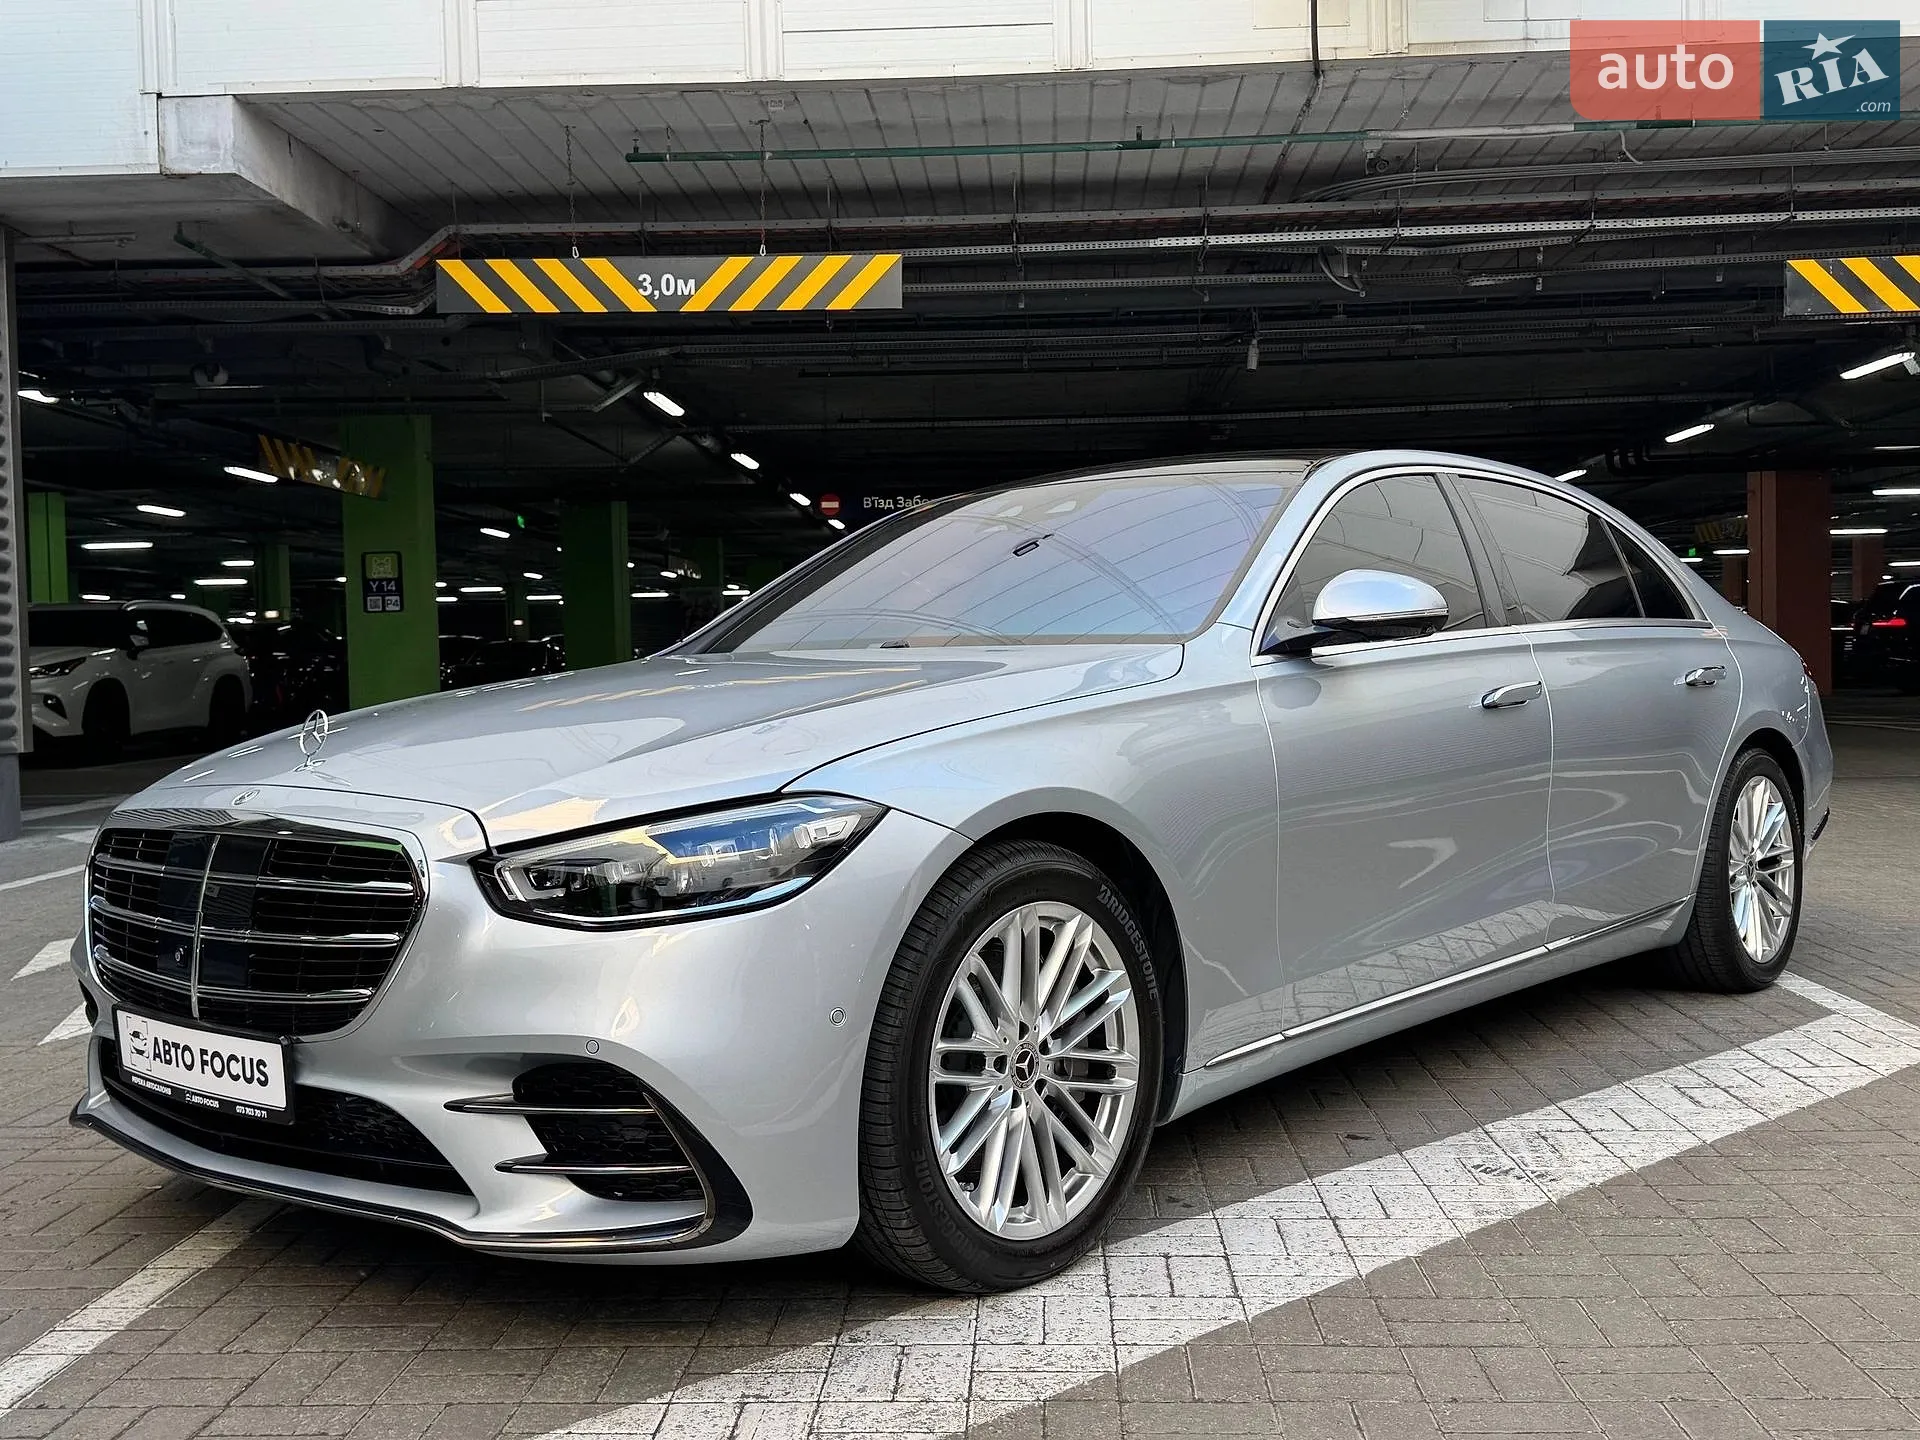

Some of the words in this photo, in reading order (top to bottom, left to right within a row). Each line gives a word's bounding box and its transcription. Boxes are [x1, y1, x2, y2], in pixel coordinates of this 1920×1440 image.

[381, 580, 396, 592] 14
[1096, 883, 1160, 1001] BRIDGESTONE
[152, 1036, 195, 1072] АВТО
[199, 1047, 269, 1088] FOCUS
